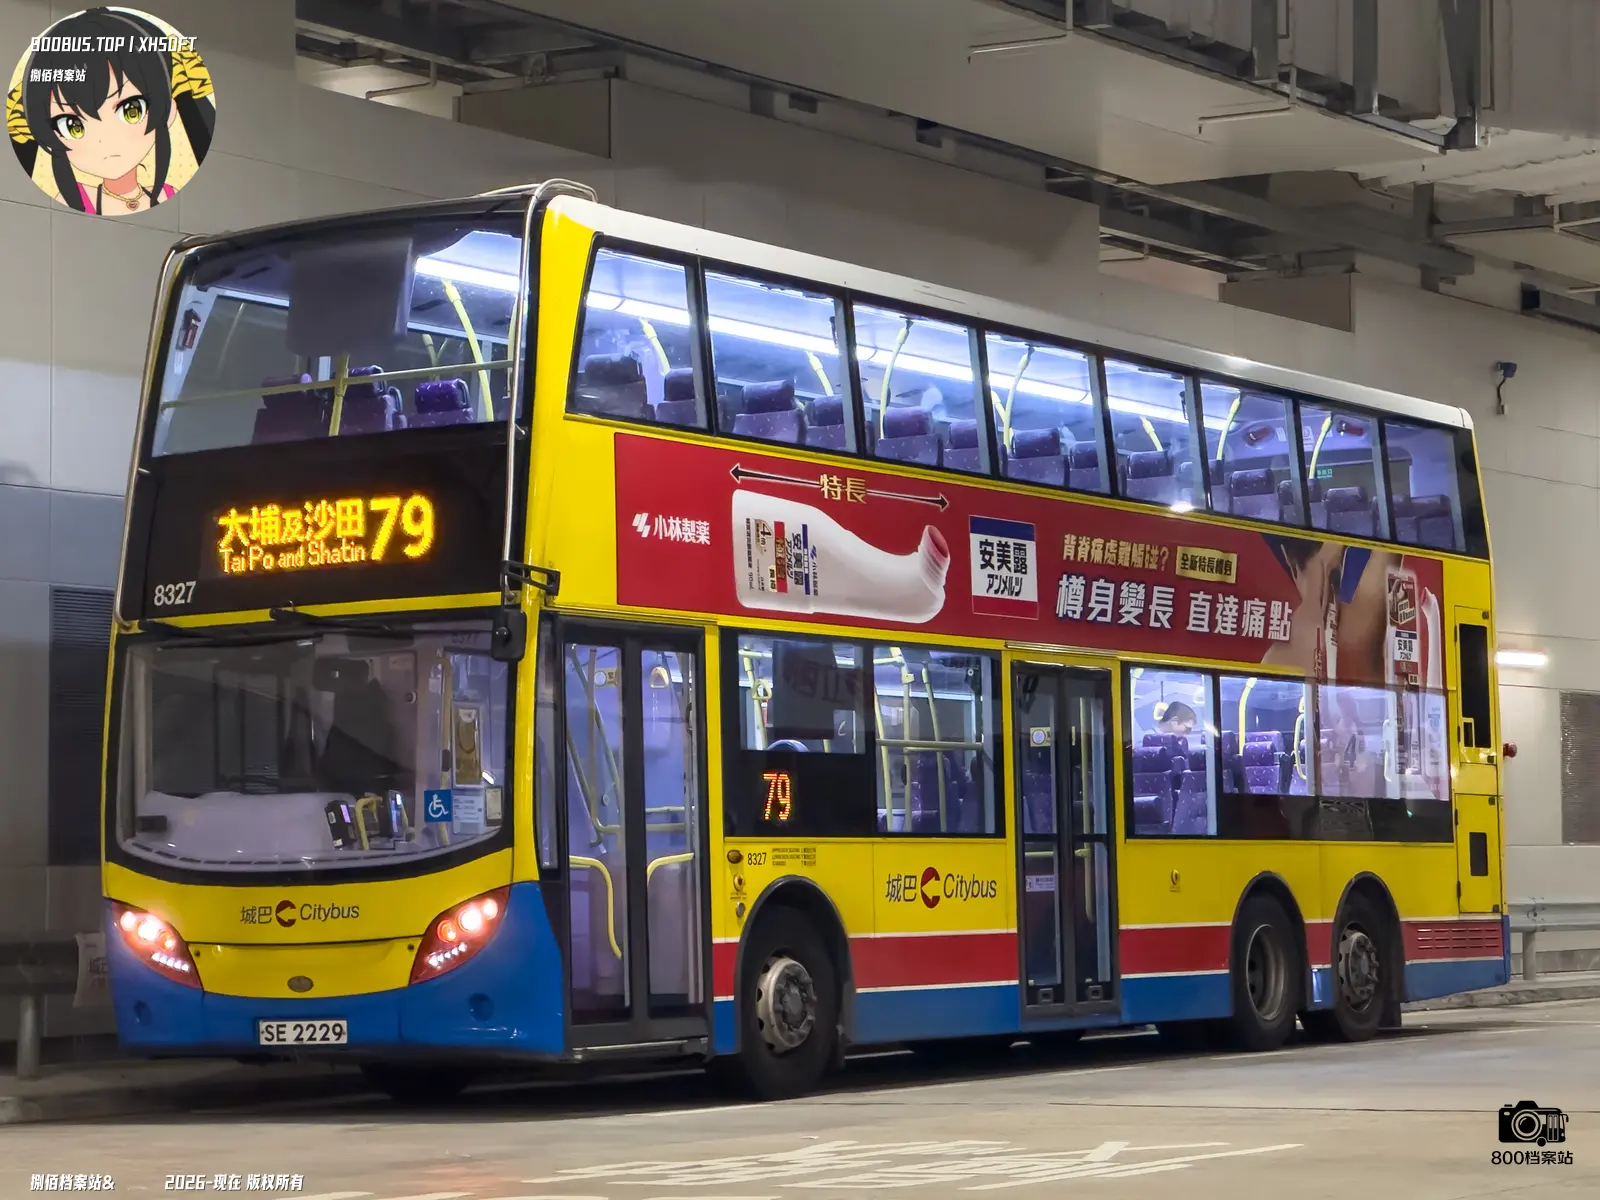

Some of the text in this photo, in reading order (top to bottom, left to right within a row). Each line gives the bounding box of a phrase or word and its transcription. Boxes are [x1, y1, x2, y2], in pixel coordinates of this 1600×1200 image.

[820, 473, 867, 505] 特長
[218, 498, 364, 546] 大埔及沙田
[369, 494, 434, 559] 79
[219, 538, 366, 574] Tai Po and Shatin
[979, 538, 1029, 575] 安美露
[154, 580, 197, 606] 8327
[985, 573, 1024, 597] アンメルツ
[1055, 573, 1176, 629] 樽身變長
[1186, 591, 1294, 642] 直達痛點
[762, 772, 791, 821] 79
[747, 852, 767, 866] 8327
[885, 872, 998, 903] 城巴 Citybus
[240, 902, 360, 925] 城巴 Citybus
[264, 1022, 344, 1043] SE 2229
